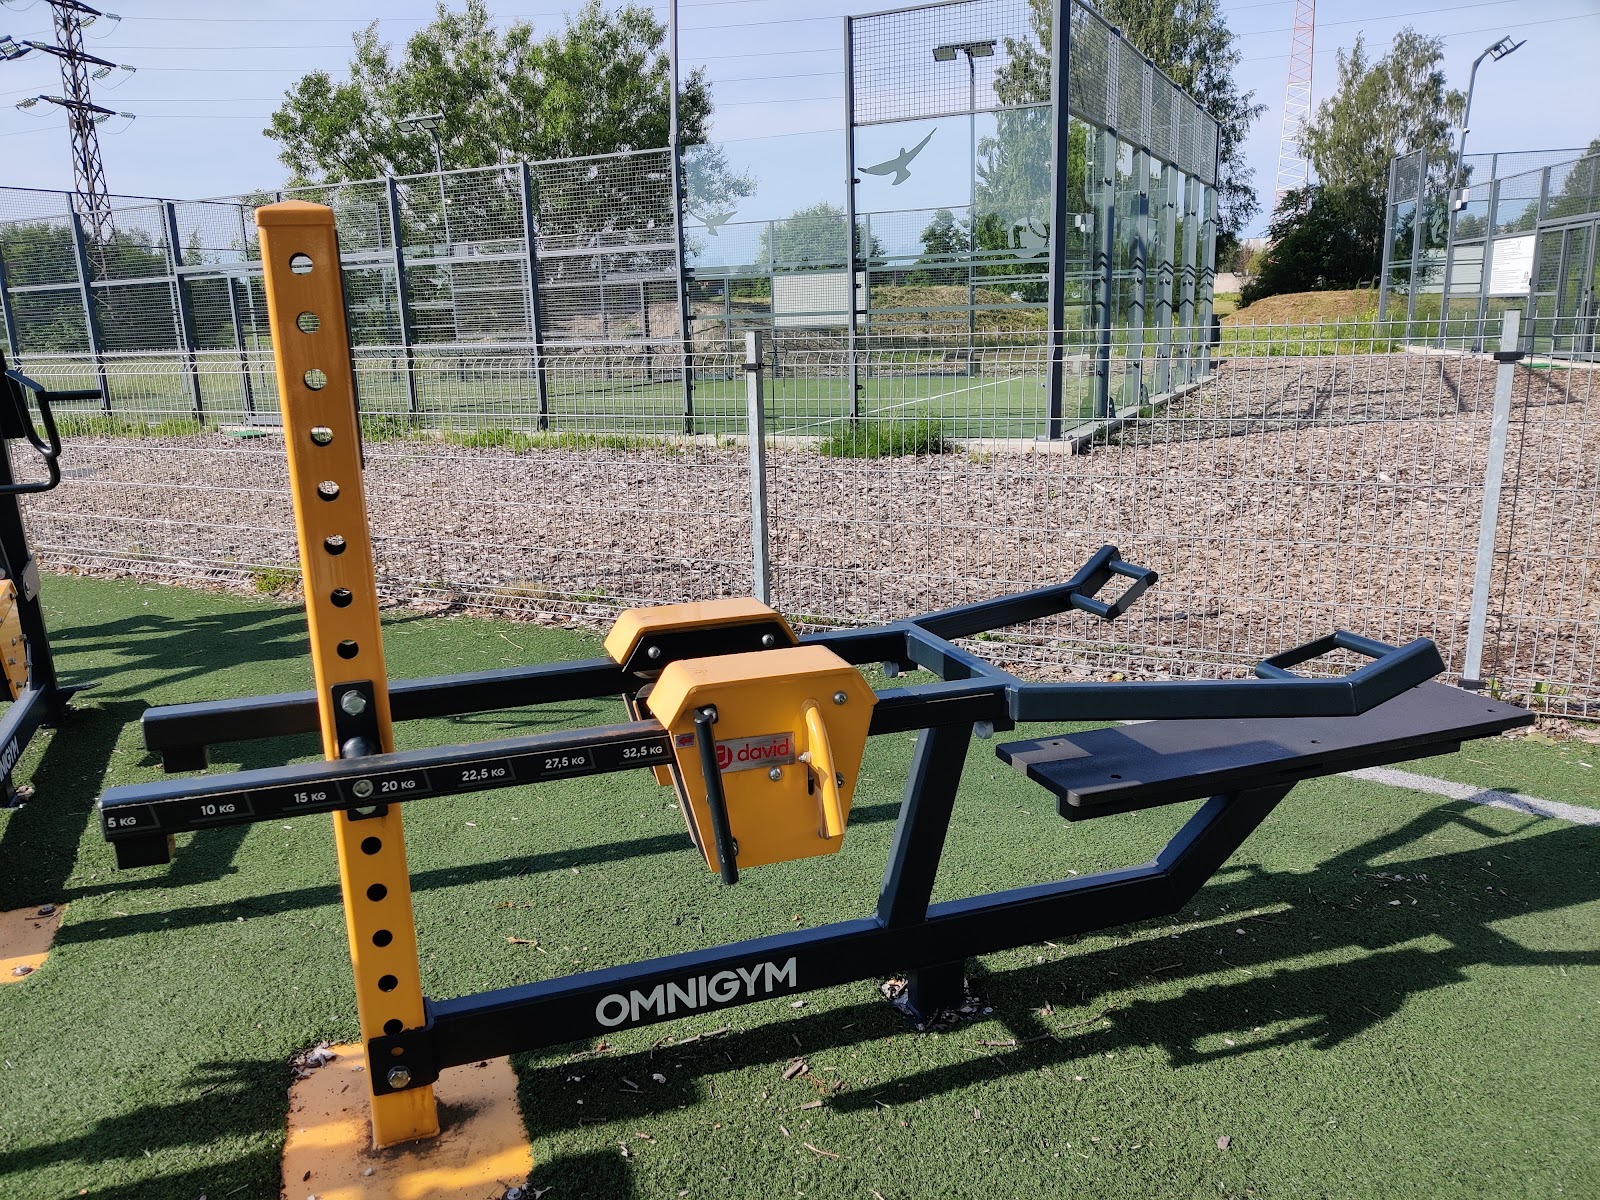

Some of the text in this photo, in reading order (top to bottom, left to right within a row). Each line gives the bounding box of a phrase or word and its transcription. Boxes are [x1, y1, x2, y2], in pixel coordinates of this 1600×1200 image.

[622, 745, 663, 759] 32,5 KG
[737, 738, 789, 762] david
[545, 756, 585, 769] 27,5 KG
[461, 768, 506, 781] 22,5 KG
[381, 779, 416, 792] 20 KG
[294, 791, 327, 803] 15 KG
[200, 803, 236, 816] 10 KG
[107, 816, 137, 828] 5 KG
[595, 956, 797, 1027] OMNIGYM
